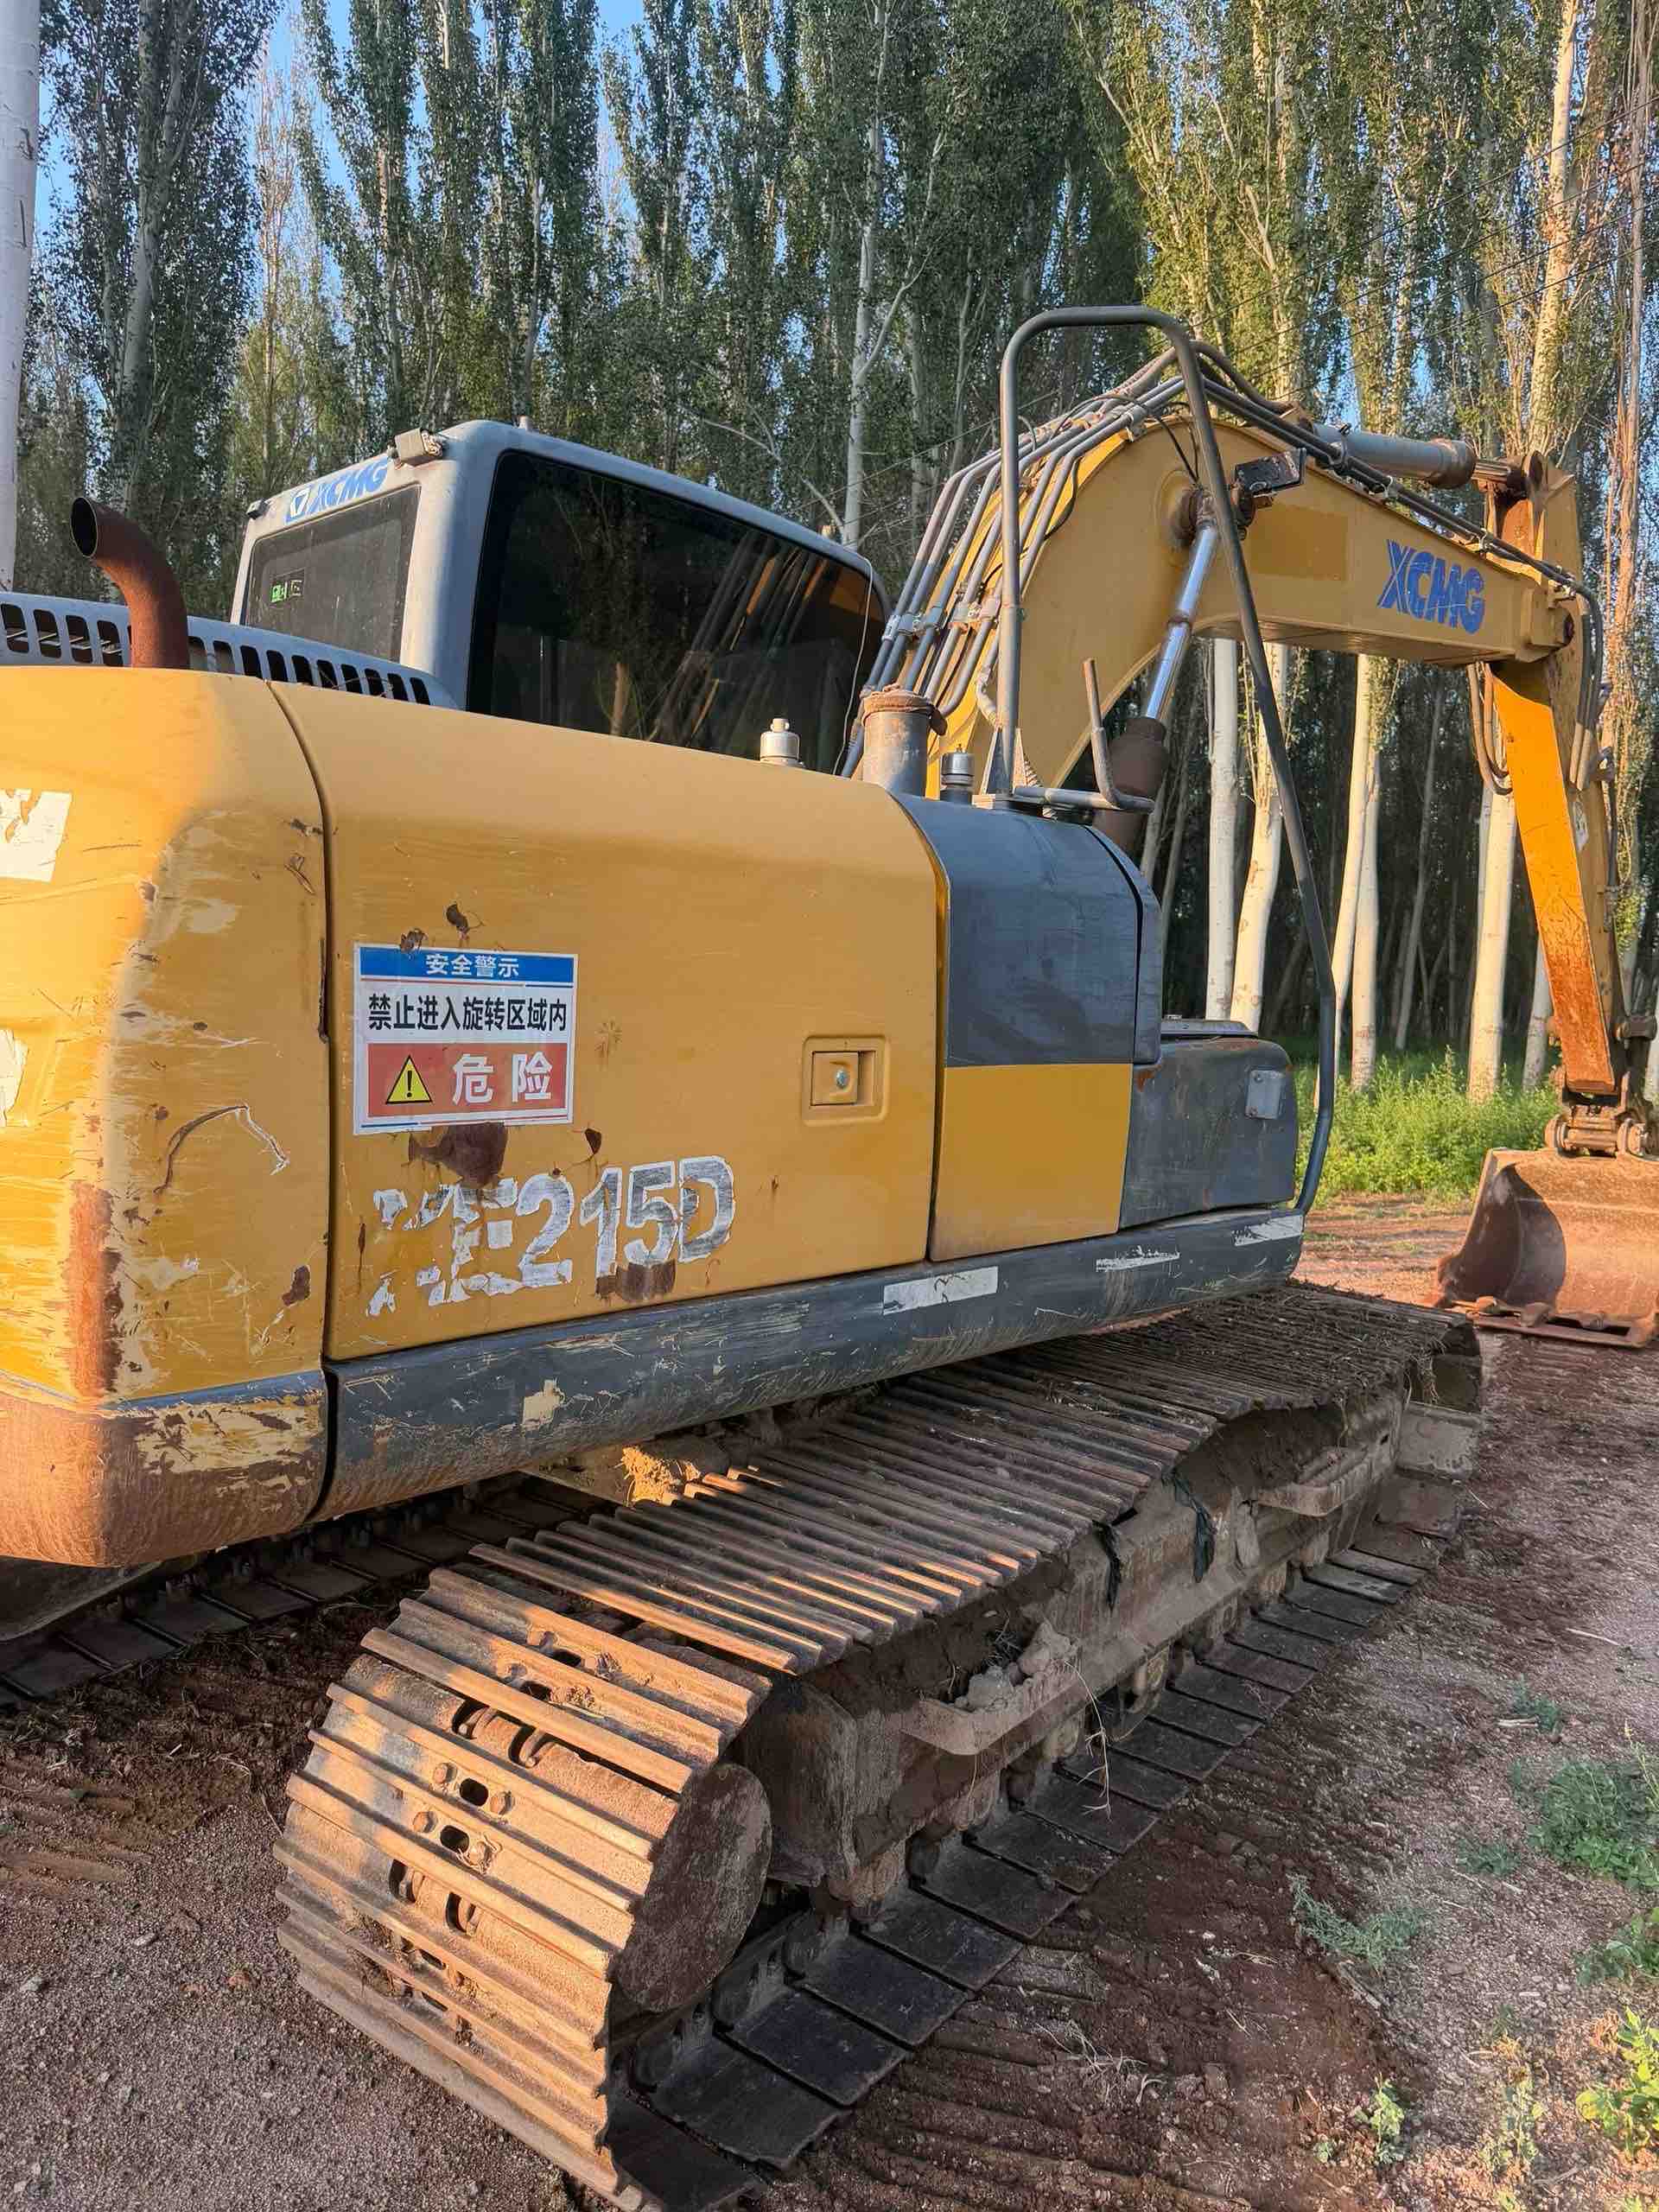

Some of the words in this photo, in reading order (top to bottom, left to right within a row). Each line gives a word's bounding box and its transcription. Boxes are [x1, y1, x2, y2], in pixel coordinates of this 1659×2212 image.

[306, 455, 388, 516] XCMG
[1376, 538, 1485, 635] XCMG
[425, 953, 520, 978] 安全警示
[368, 993, 567, 1032] 禁止进入旋转区域内
[452, 1051, 553, 1106] 危险
